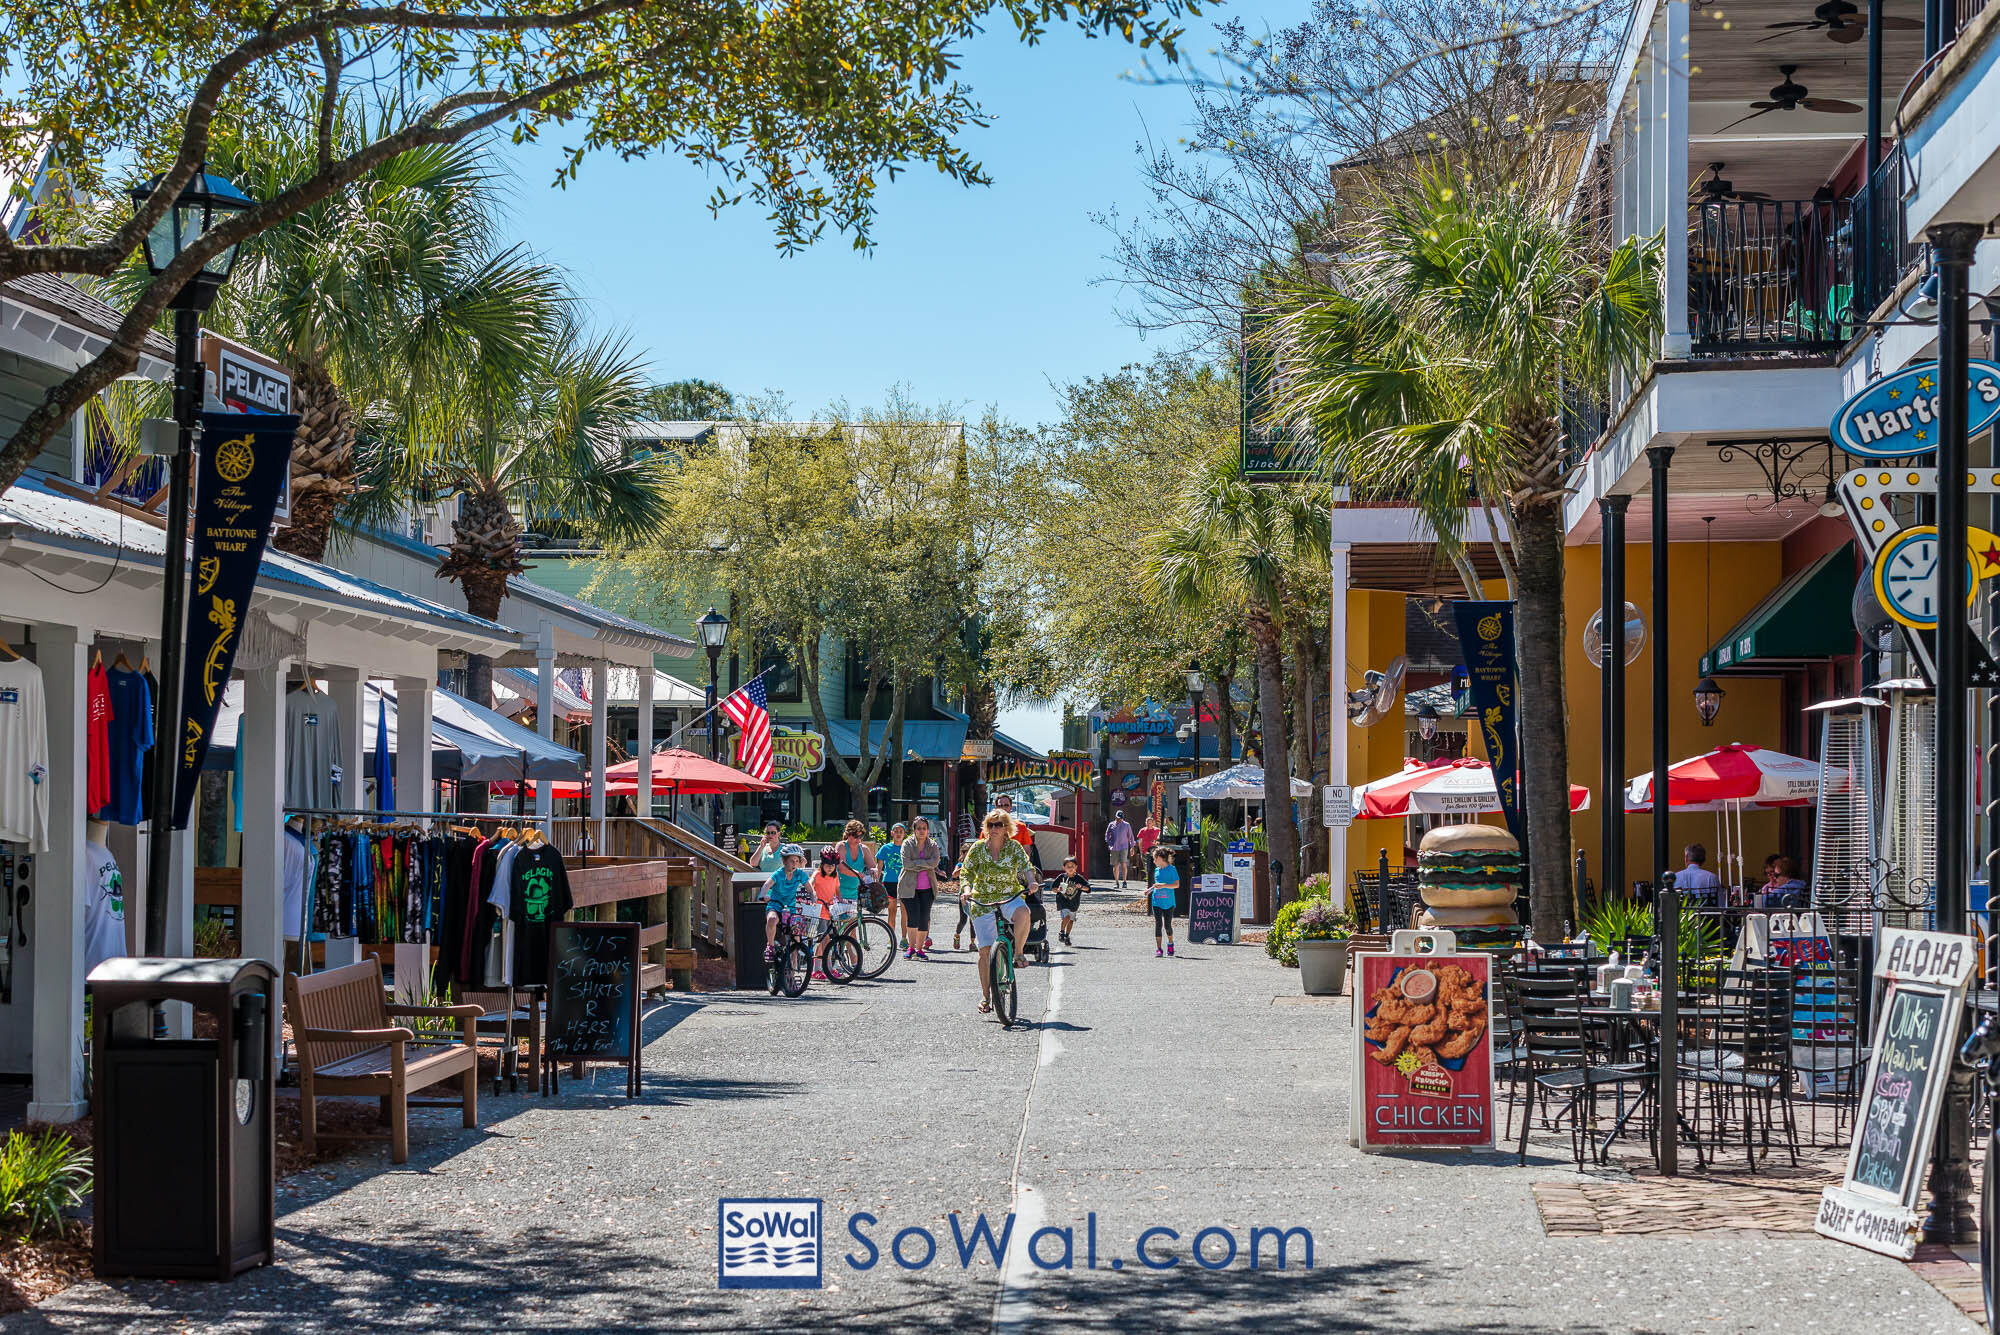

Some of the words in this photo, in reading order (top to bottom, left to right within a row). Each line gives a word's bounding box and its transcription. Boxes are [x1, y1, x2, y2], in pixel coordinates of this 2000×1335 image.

[226, 363, 287, 413] PELAGIC
[1247, 460, 1280, 469] Since
[221, 487, 247, 497] The
[214, 499, 252, 510] Village
[225, 513, 238, 526] of
[206, 527, 257, 539] BAYTOWNE
[215, 541, 248, 552] WHARF
[781, 769, 793, 779] BAR
[987, 757, 1041, 782] ILLAGE
[1045, 758, 1095, 793] DOOR
[1332, 788, 1343, 798] NO
[1441, 796, 1454, 804] STILL
[1196, 909, 1226, 922] Bloody
[1887, 935, 1963, 979] ALOHA
[582, 956, 632, 977] PADDY'S
[569, 981, 624, 999] SHIRTS
[586, 1000, 598, 1017] R
[567, 1017, 620, 1037] HERE!
[1880, 1038, 1907, 1075] Maui
[1904, 1044, 1928, 1072] Jim
[1420, 1070, 1445, 1079] KRISPY
[1415, 1084, 1447, 1092] CHICKEN
[1876, 1072, 1912, 1103] Costa
[1375, 1105, 1483, 1126] CHICKEN
[1857, 1152, 1896, 1190] Oakley
[1820, 1199, 1855, 1234] SURF
[1854, 1209, 1914, 1248] COMPANY
